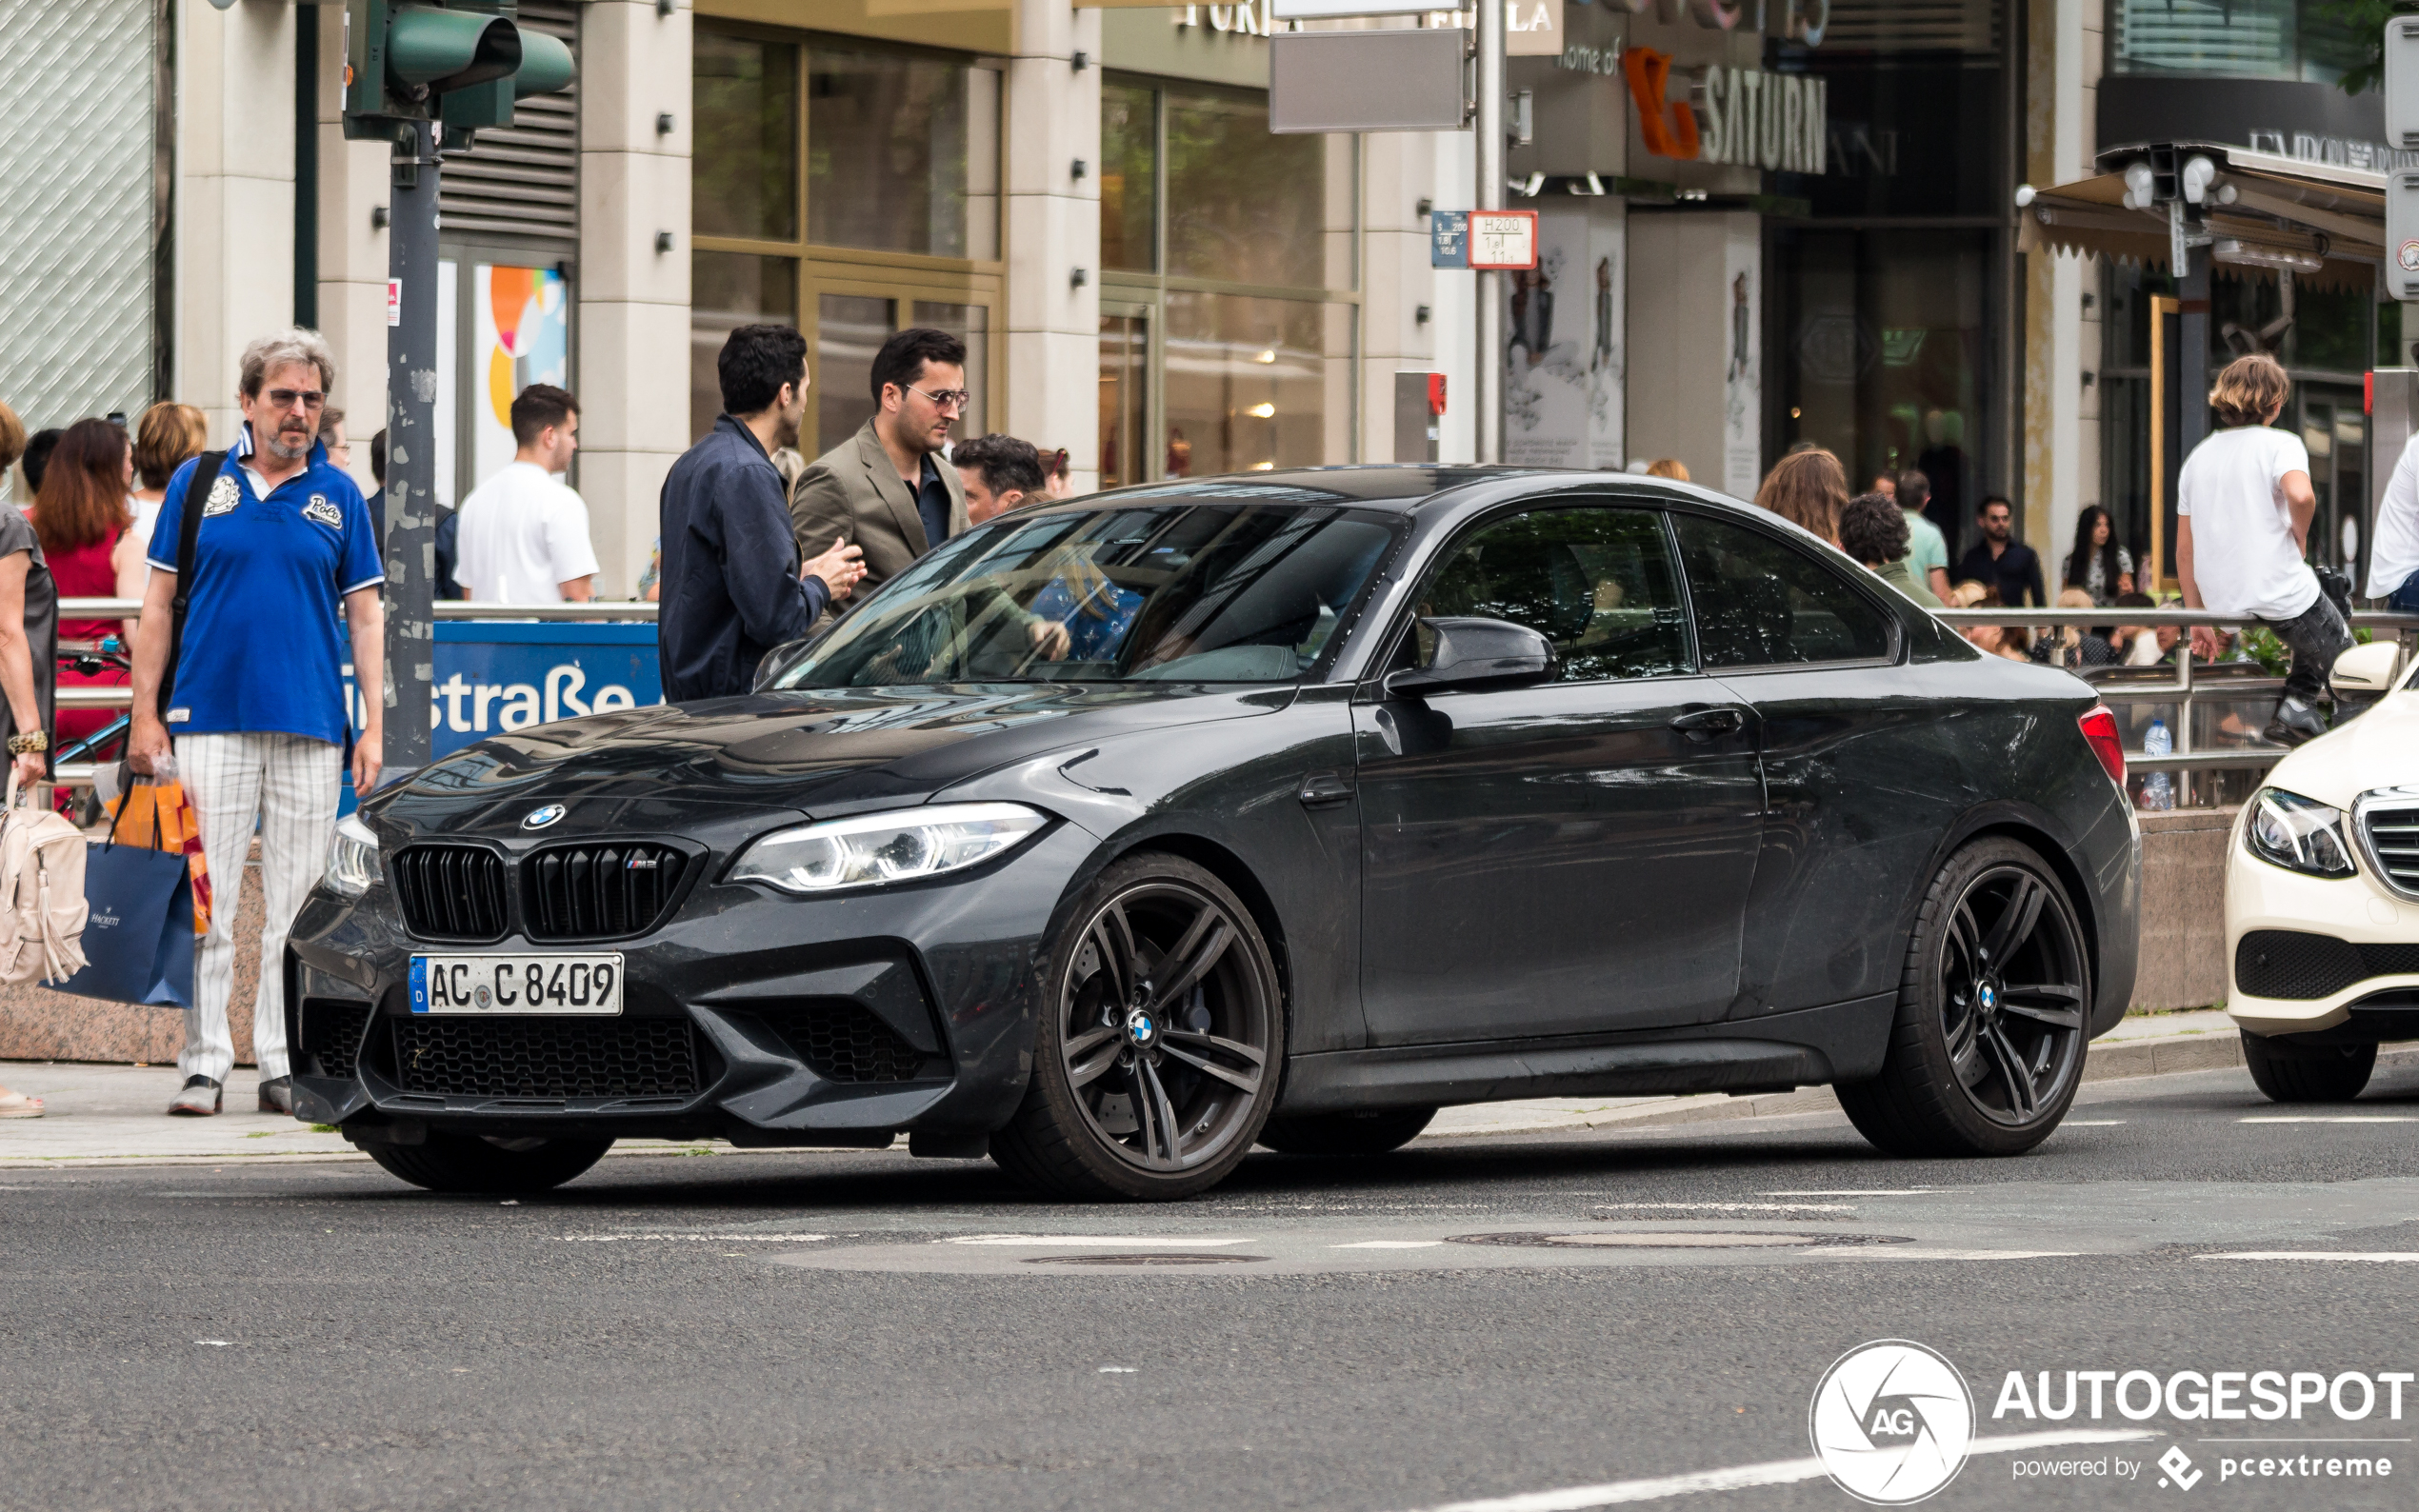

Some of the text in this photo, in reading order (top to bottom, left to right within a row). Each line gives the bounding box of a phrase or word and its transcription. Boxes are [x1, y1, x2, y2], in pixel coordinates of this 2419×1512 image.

[1703, 64, 1828, 175] SATURN
[1452, 223, 1468, 232] 200
[634, 860, 657, 869] M2
[91, 913, 121, 926] HACKETT
[431, 963, 614, 1006] AC C 8409
[415, 990, 423, 1003] D
